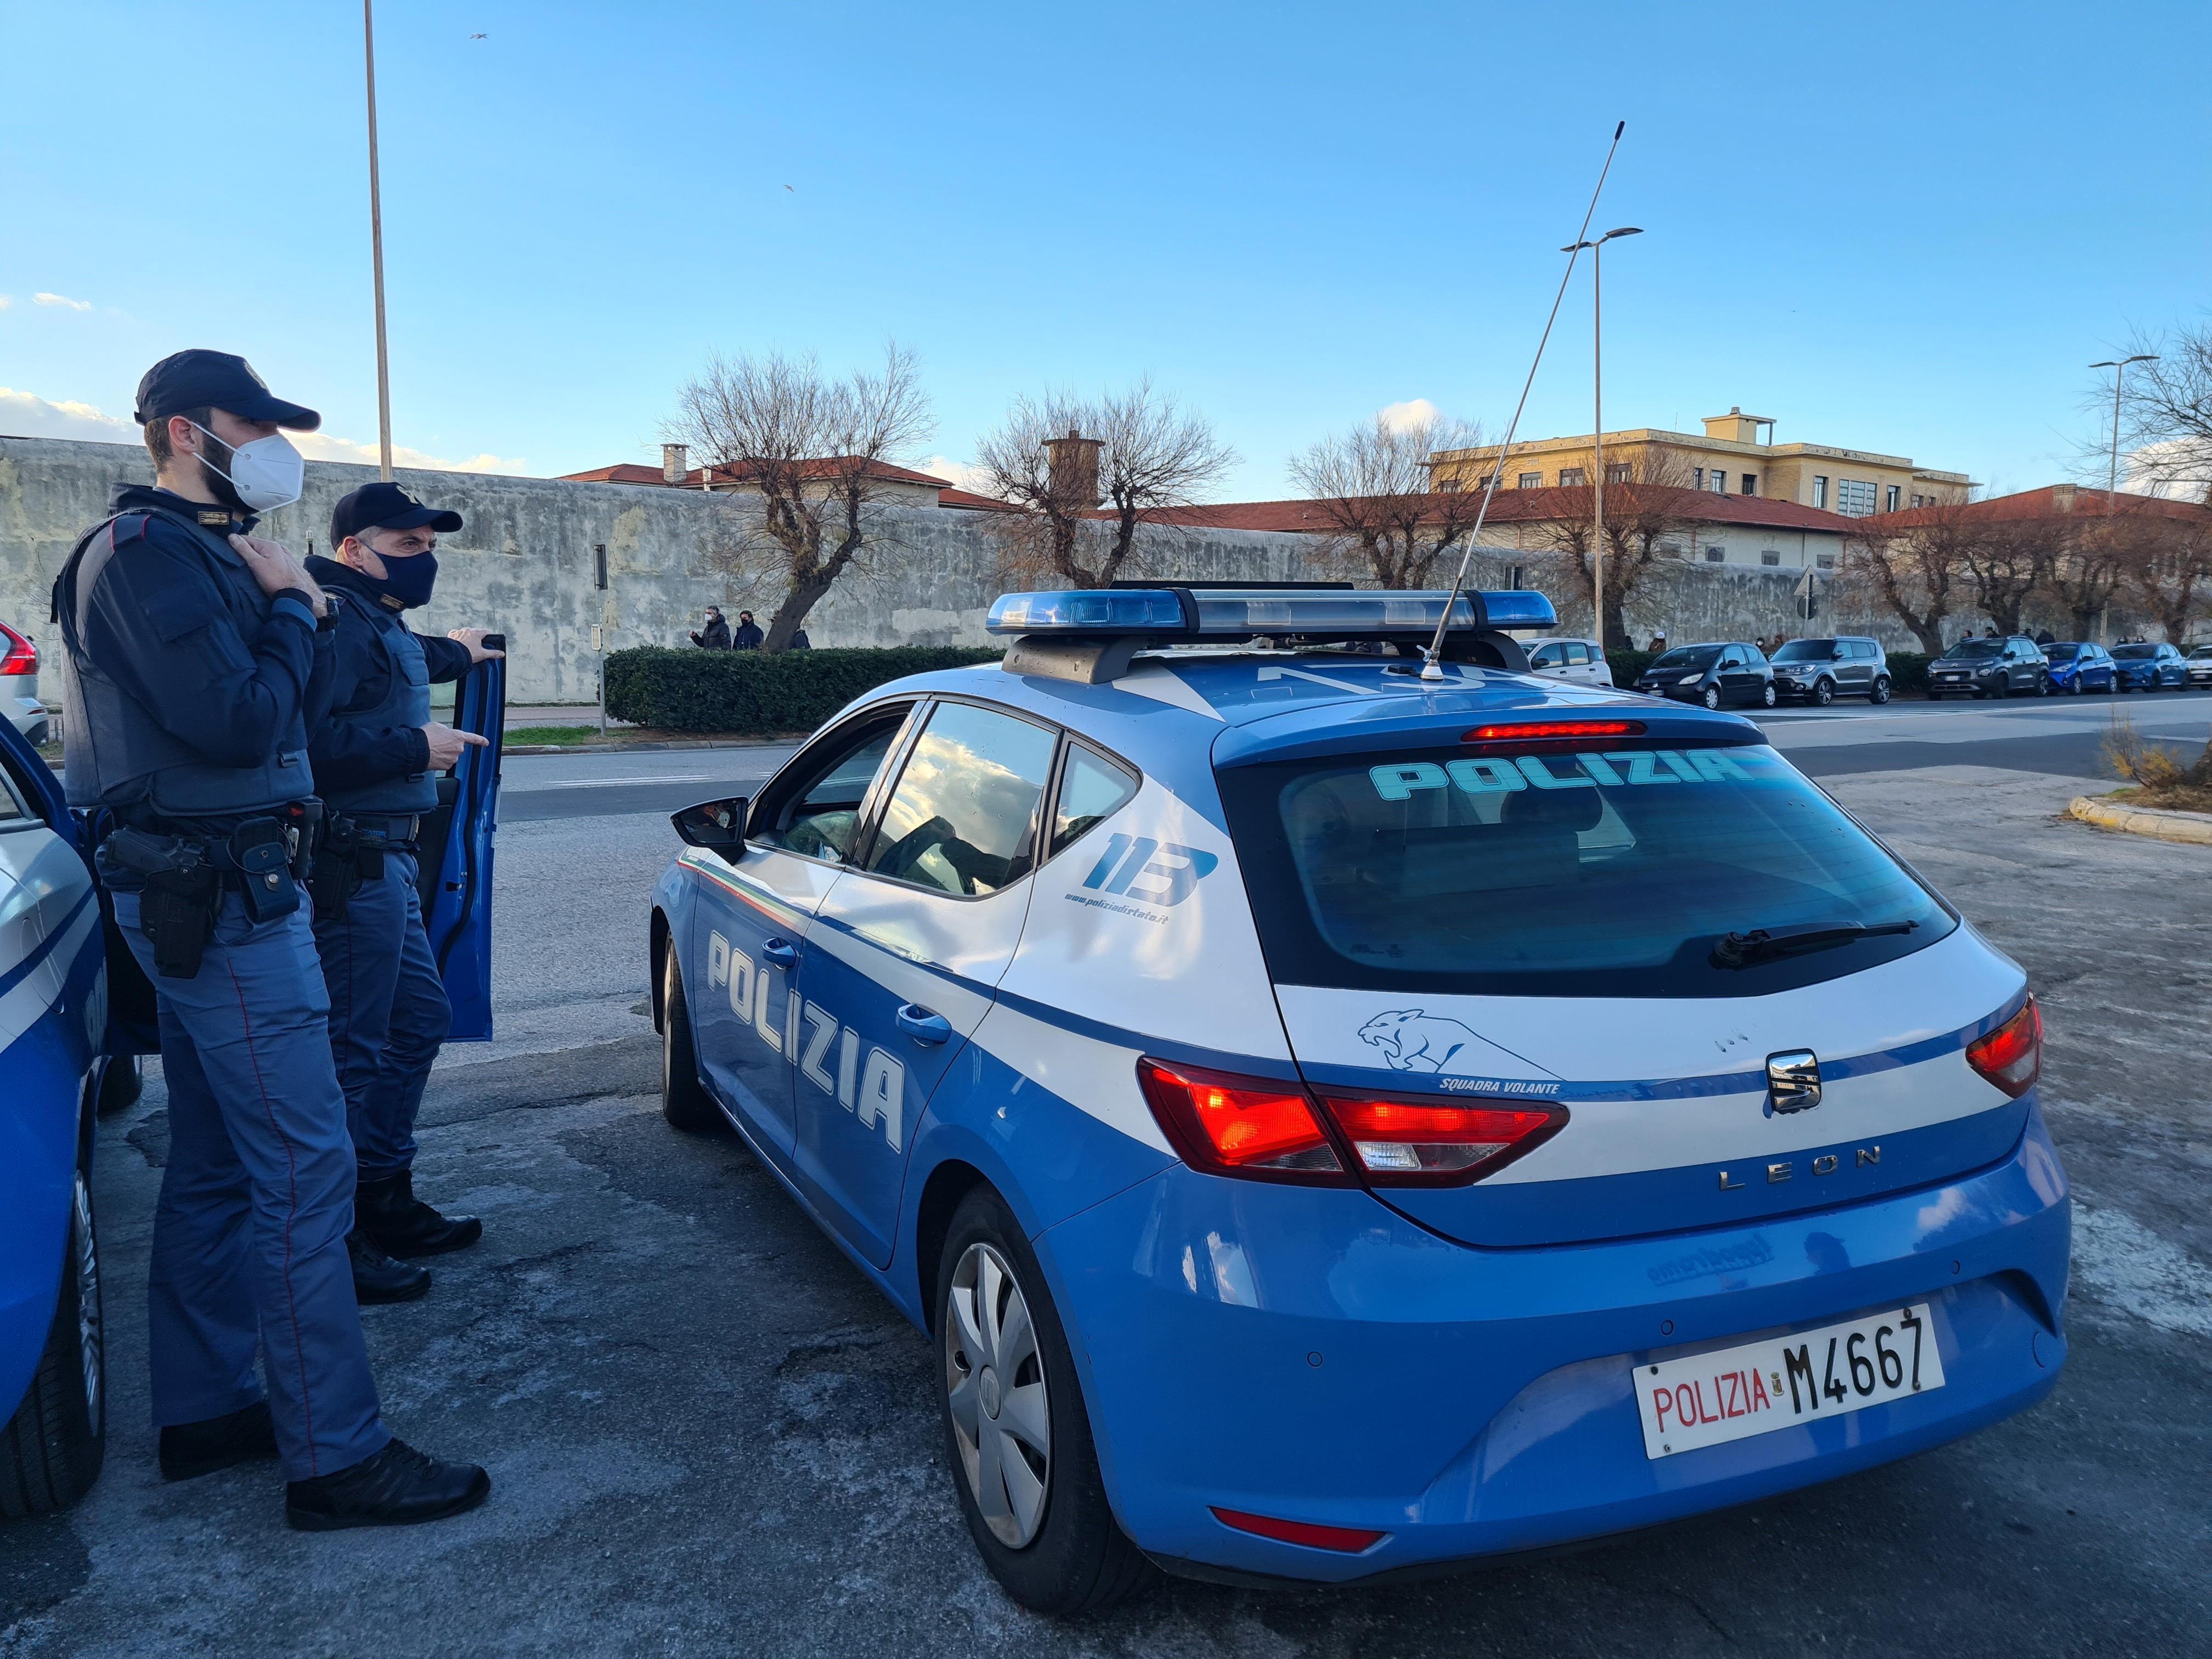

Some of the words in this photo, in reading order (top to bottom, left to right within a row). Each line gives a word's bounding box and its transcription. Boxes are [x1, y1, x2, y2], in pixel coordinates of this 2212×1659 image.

[1369, 751, 1754, 800] POLIZIA
[1082, 833, 1218, 907] 113
[1064, 893, 1170, 925] www.poliziadistato.it
[707, 929, 905, 1154] POLIZIA
[1440, 1078, 1500, 1091] SQUADRA
[1504, 1082, 1560, 1094] VOLANTE
[1719, 1146, 1881, 1192] LEON
[1653, 1368, 1770, 1432] POLIZIA
[1783, 1317, 1922, 1414] M4667
